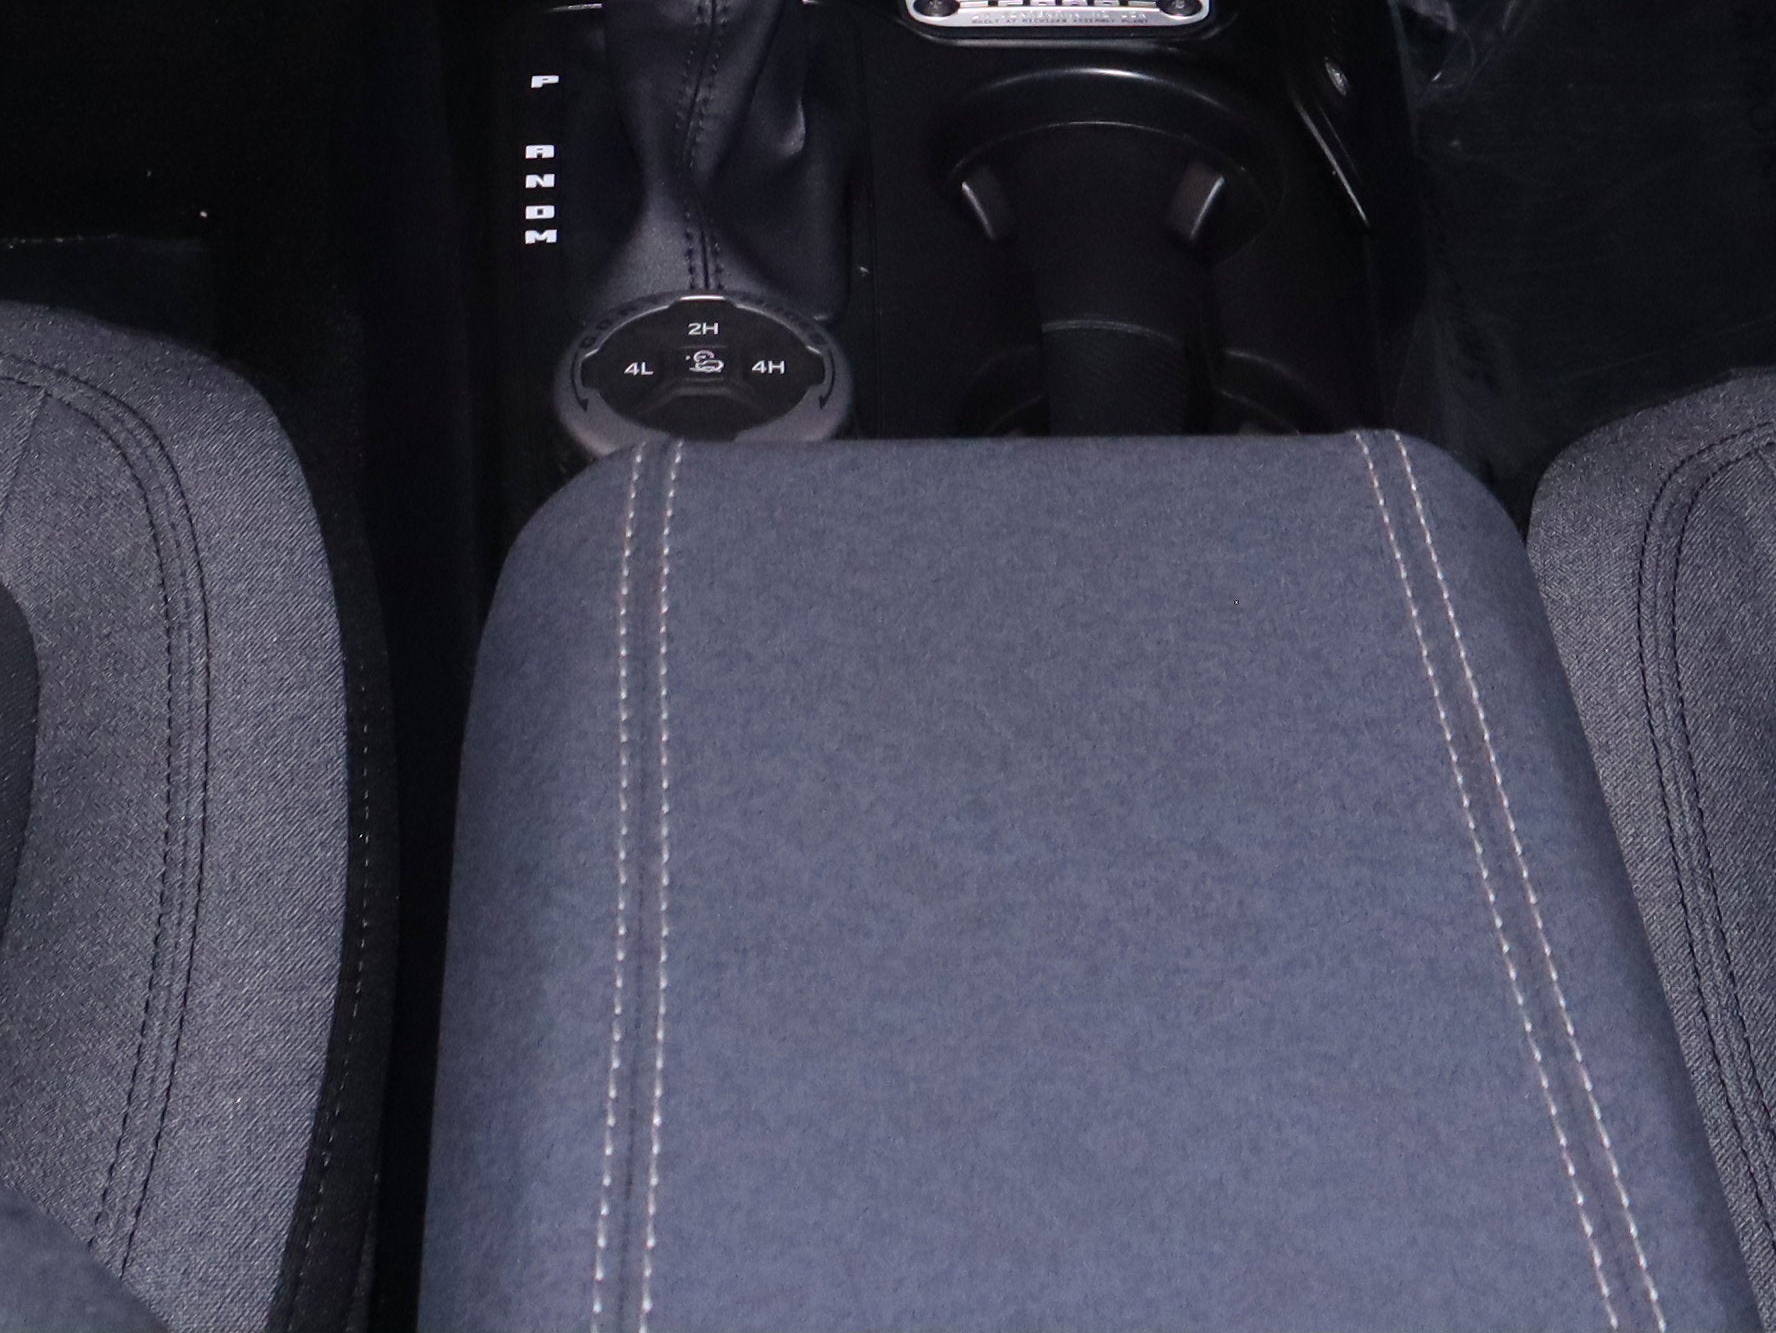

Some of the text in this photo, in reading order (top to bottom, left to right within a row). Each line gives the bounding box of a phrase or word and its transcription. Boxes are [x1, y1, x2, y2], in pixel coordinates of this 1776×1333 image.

[530, 74, 560, 89] P
[524, 173, 555, 189] N
[524, 204, 555, 220] D
[524, 229, 558, 245] M
[687, 322, 720, 336] 2H
[624, 361, 654, 376] 4L
[751, 360, 786, 375] 4H
